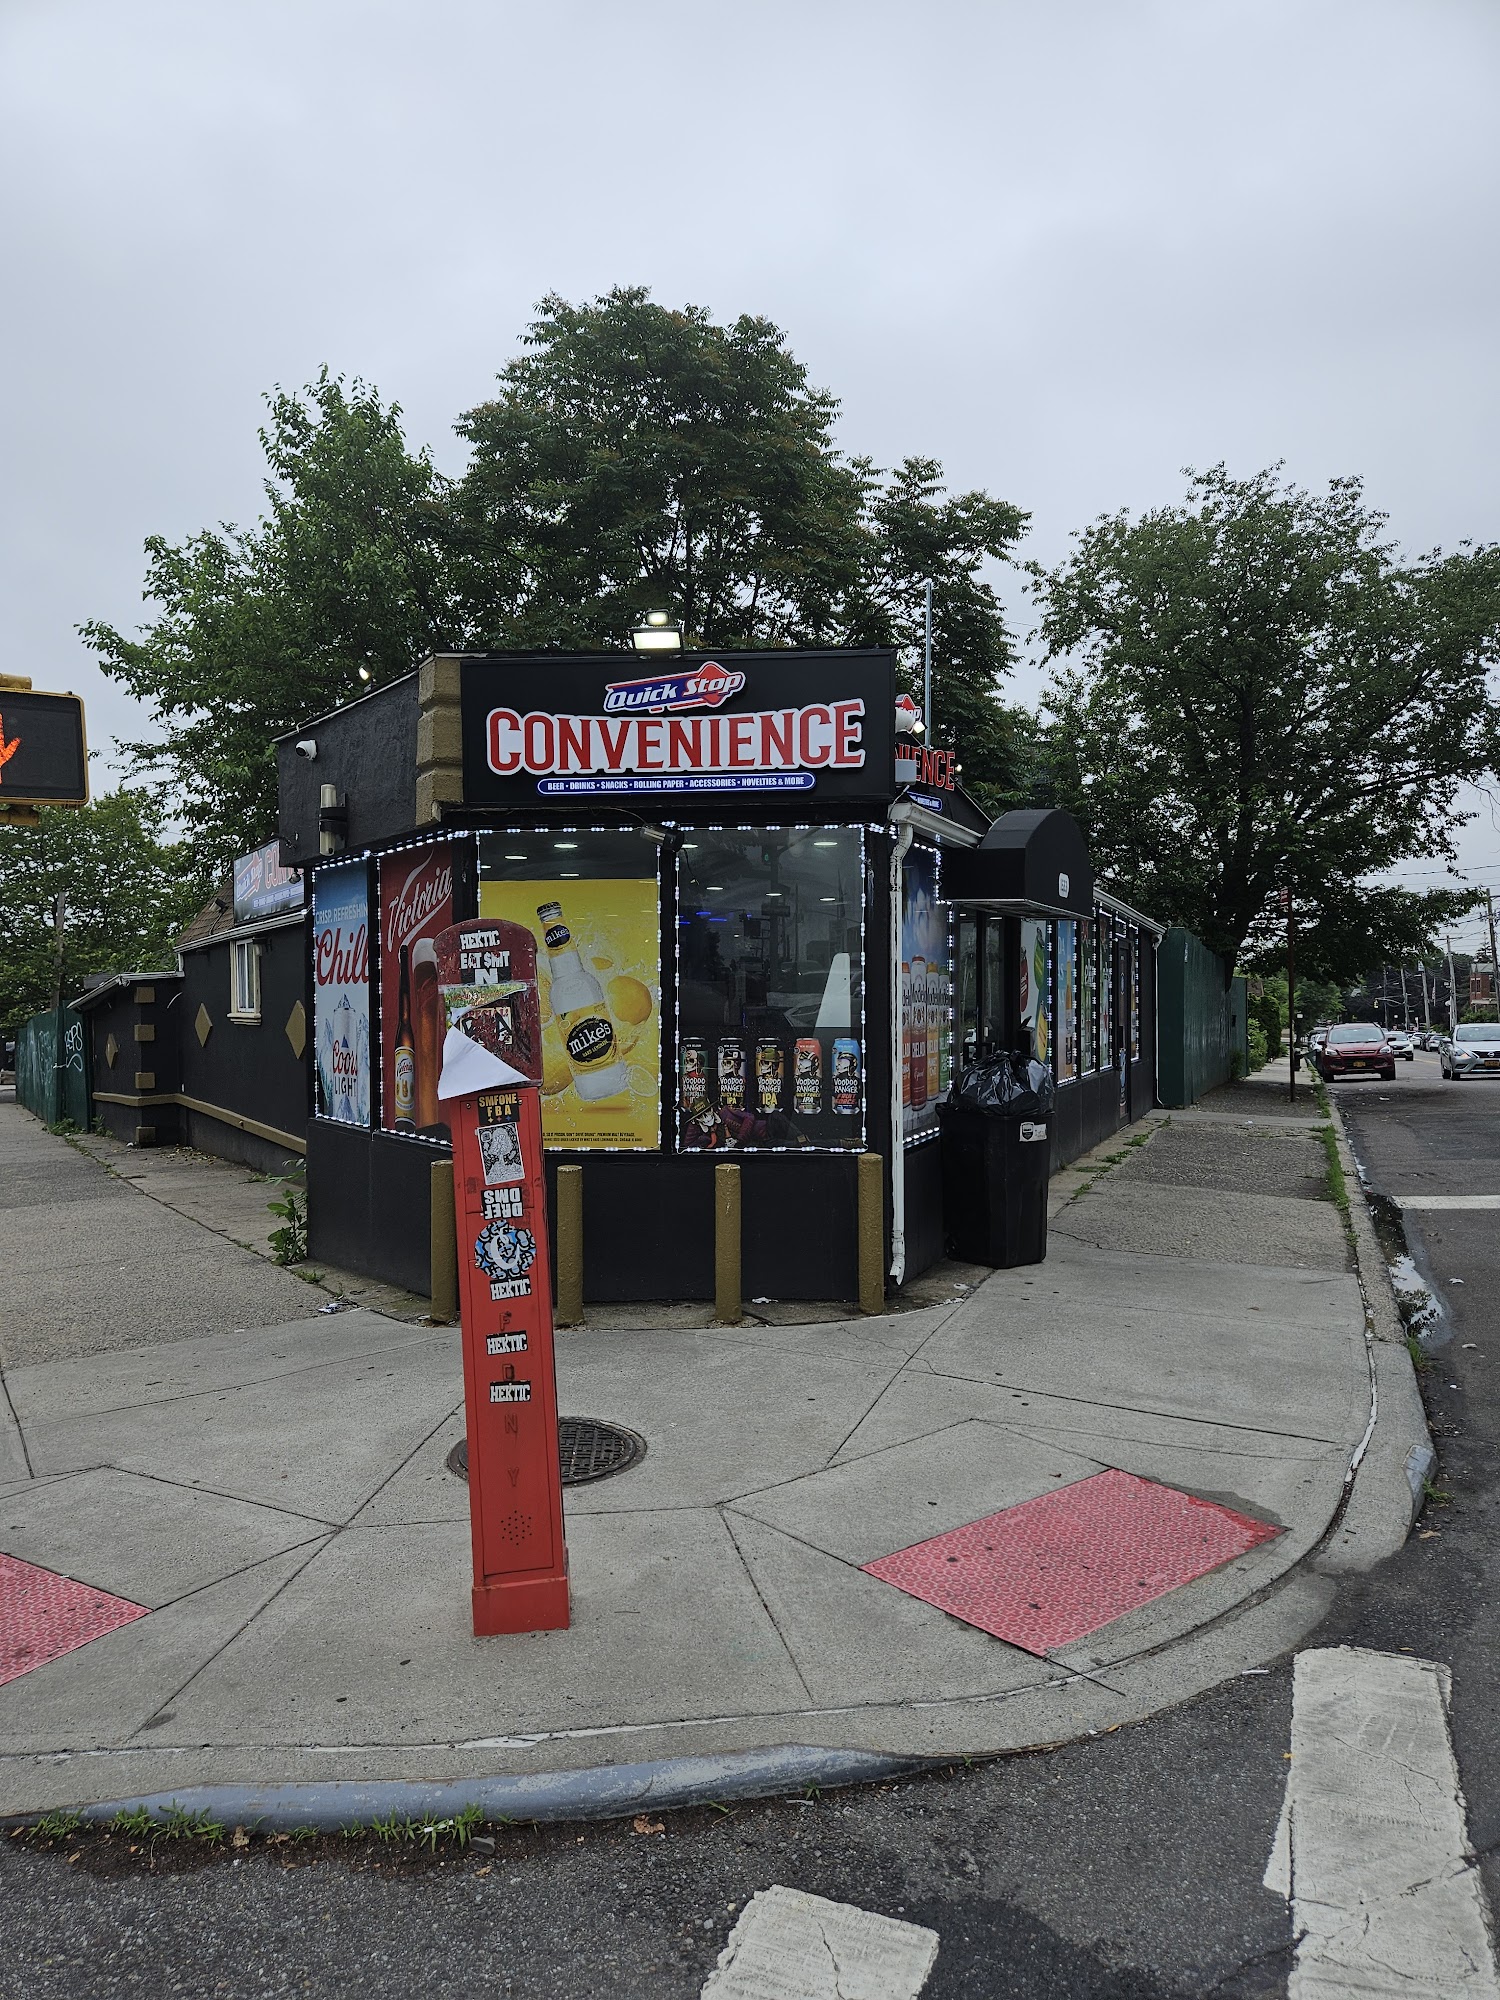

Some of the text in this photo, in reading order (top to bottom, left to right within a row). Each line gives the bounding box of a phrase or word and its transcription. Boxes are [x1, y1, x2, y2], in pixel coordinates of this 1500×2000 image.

[608, 673, 742, 710] Quick Stop
[487, 700, 865, 772] CONVENIENCE
[547, 776, 805, 791] BEER DRINKS SNACKS ROLLING PAPER ACCESSORIES NOVELTIES & MORE
[387, 849, 452, 953] Victoria
[460, 930, 500, 950] HEKTIC
[545, 928, 570, 945] mike's
[315, 923, 369, 986] Chill
[568, 1022, 611, 1055] mike's
[333, 1040, 358, 1076] Coors
[334, 1077, 357, 1097] LIGHT
[682, 1077, 705, 1086] VOODOO
[682, 1085, 706, 1093] RANGER
[720, 1077, 743, 1086] VOODOO
[720, 1085, 744, 1093] RANGER
[757, 1077, 781, 1086] VOODOO
[758, 1085, 782, 1093] RANGER
[796, 1078, 819, 1087] VOODOO
[796, 1085, 820, 1093] RANGER
[834, 1079, 857, 1088] VOODOO
[834, 1085, 858, 1093] RANGER
[479, 1093, 518, 1108] SMFONE
[727, 1096, 738, 1105] IPA
[763, 1092, 778, 1105] IPA
[490, 1279, 531, 1300] HEKTIC
[486, 1334, 527, 1355] HEKTIC
[490, 1383, 530, 1403] HEKTIC
